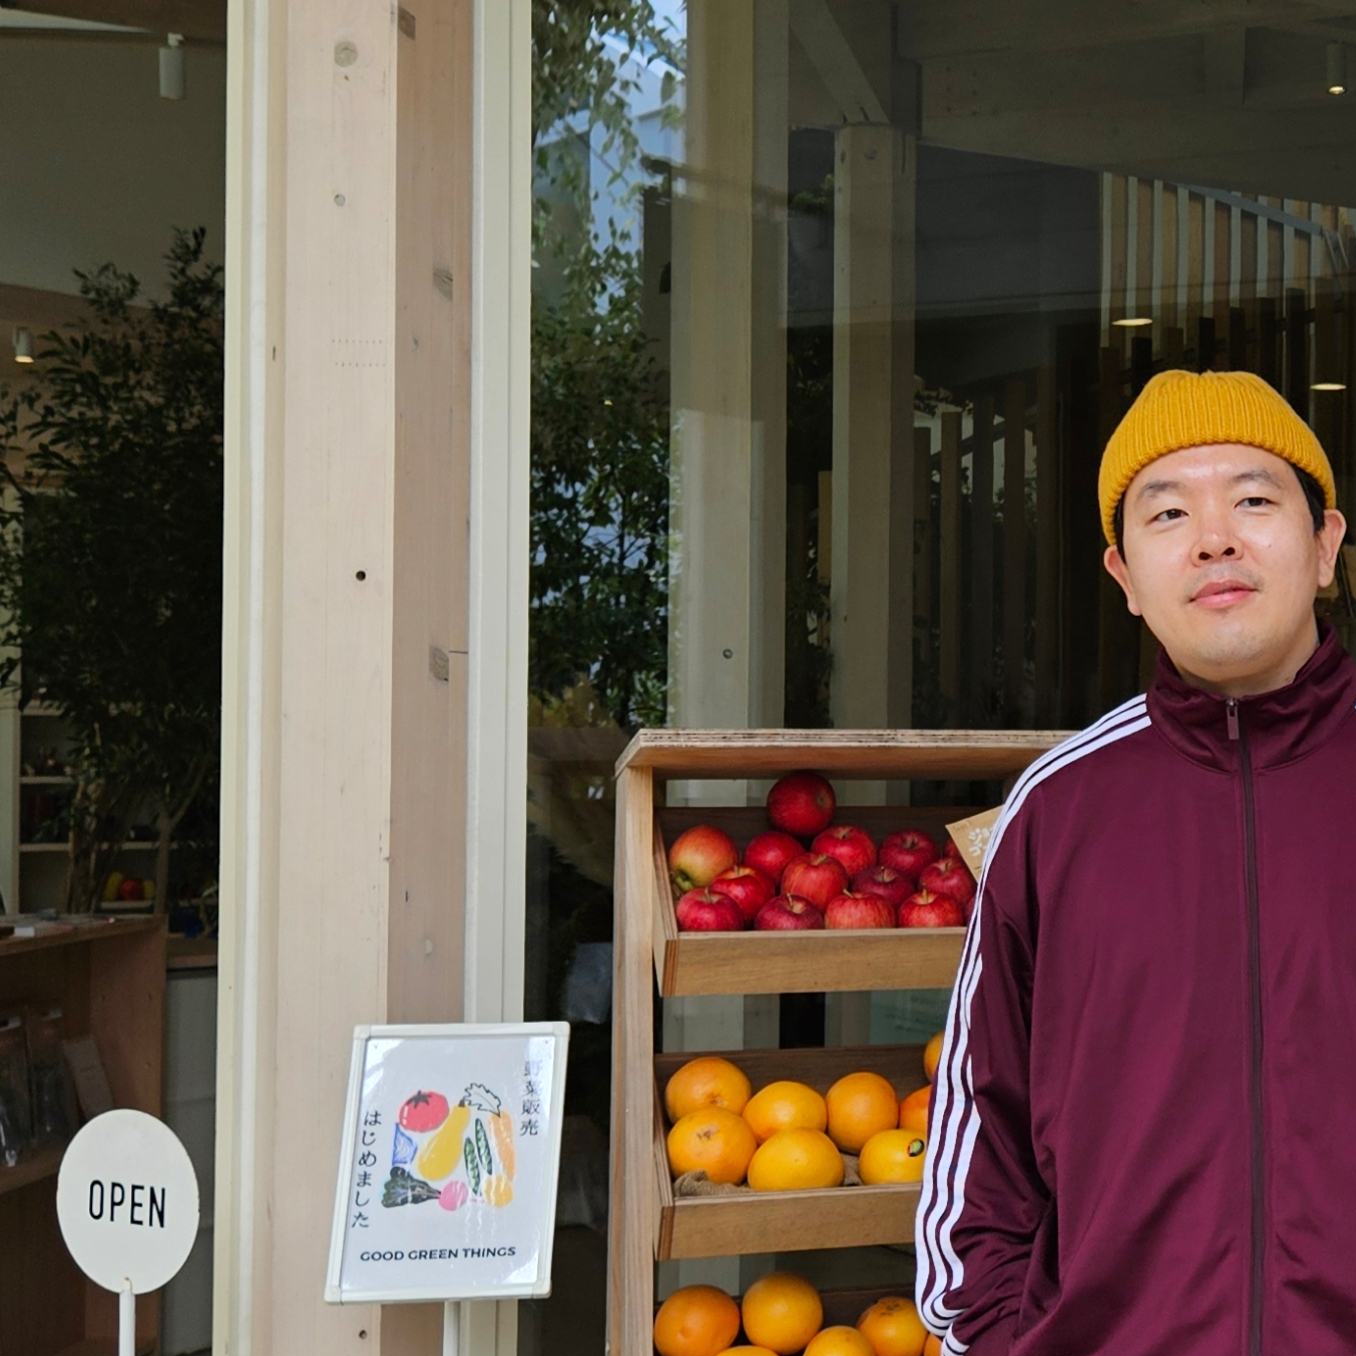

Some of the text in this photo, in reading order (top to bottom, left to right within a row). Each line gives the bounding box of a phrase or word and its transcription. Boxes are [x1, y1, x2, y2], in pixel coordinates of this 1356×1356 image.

[520, 1060, 542, 1137] 野菜販売
[351, 1109, 382, 1229] はじめました
[89, 1180, 166, 1229] OPEN
[360, 1246, 516, 1262] GOOD GREEN THINGS
